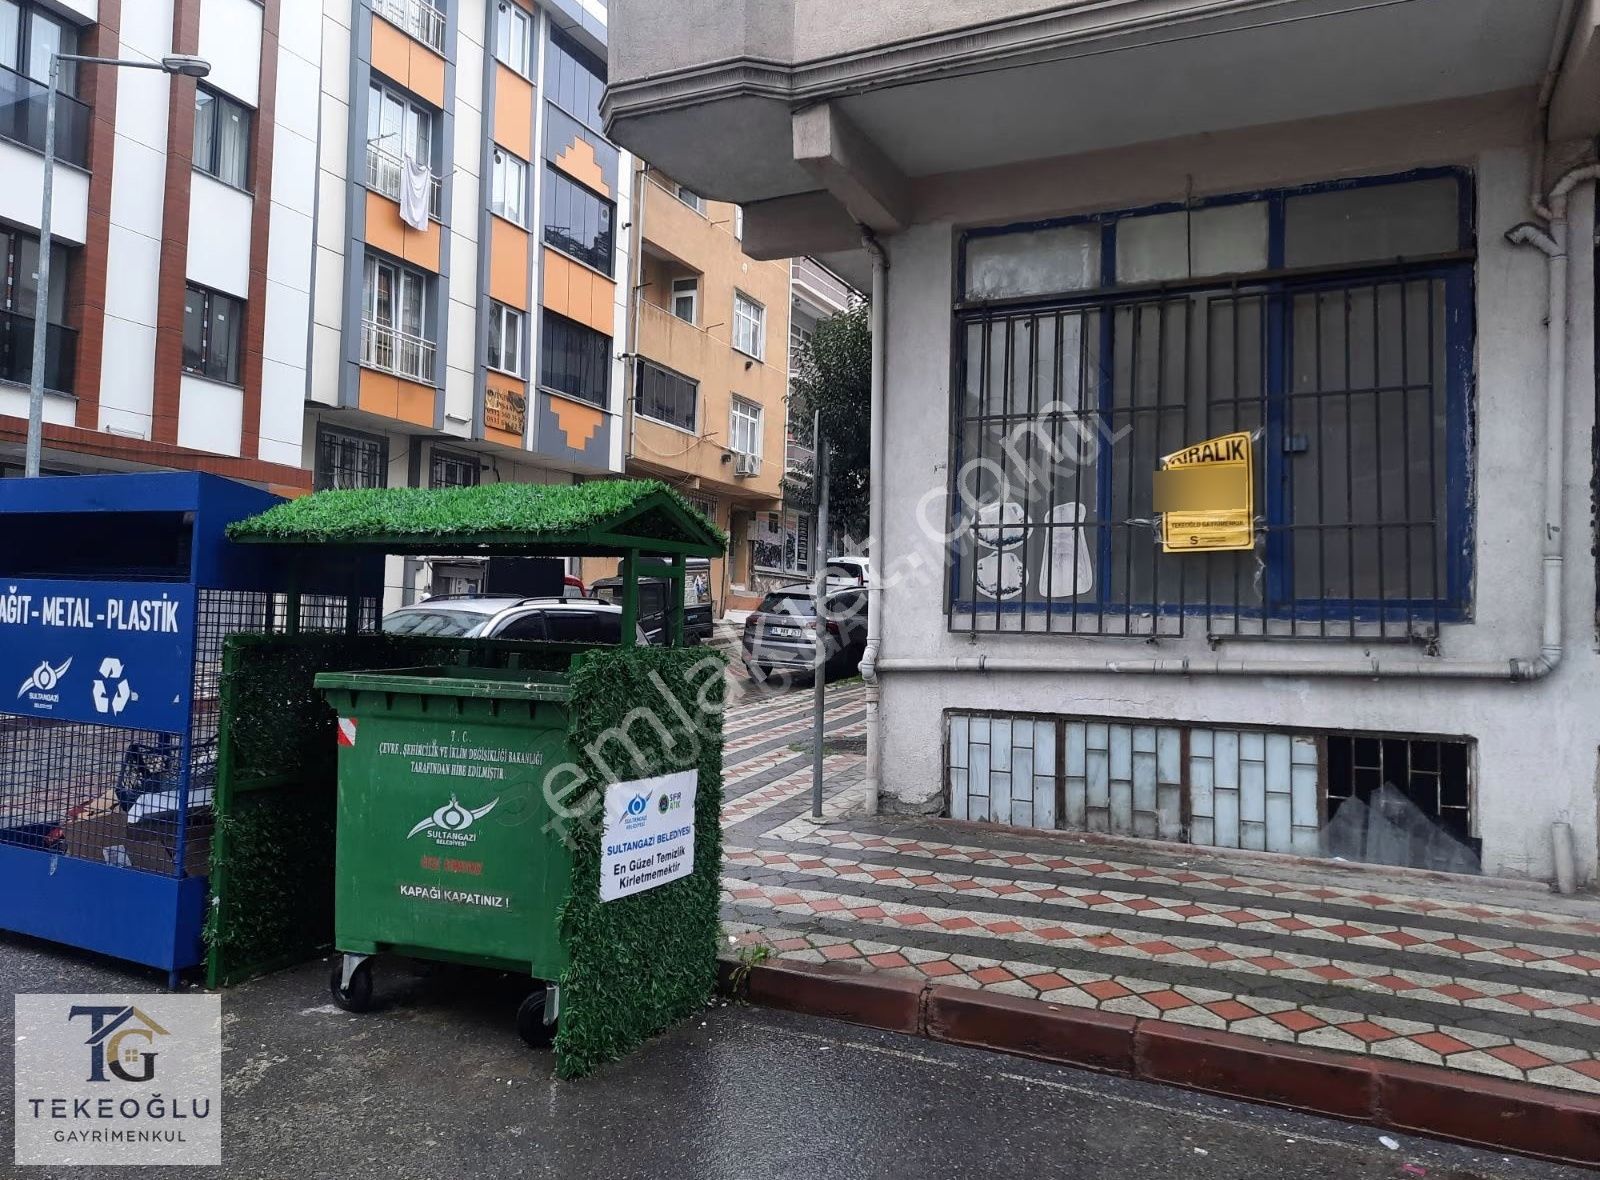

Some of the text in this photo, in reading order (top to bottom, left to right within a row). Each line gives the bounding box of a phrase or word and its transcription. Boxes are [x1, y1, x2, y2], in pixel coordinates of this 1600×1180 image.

[403, 742, 439, 757] ŞEHİRCİLİK
[440, 746, 449, 758] VE
[449, 744, 467, 760] İKLİM
[508, 750, 543, 766] BAKANLIĞI
[411, 761, 450, 775] TARAFINDAN
[427, 830, 477, 842] SULTANGAZİ
[436, 838, 467, 847] BELEDİYESİ
[607, 825, 692, 856] SULTANGAZİ BELEDİYESİ
[613, 846, 686, 876] En Güzel Temizlik
[619, 862, 681, 889] Kirletmemektir
[400, 885, 441, 900] KAPAĞI
[444, 891, 503, 908] KAPATINIZ
